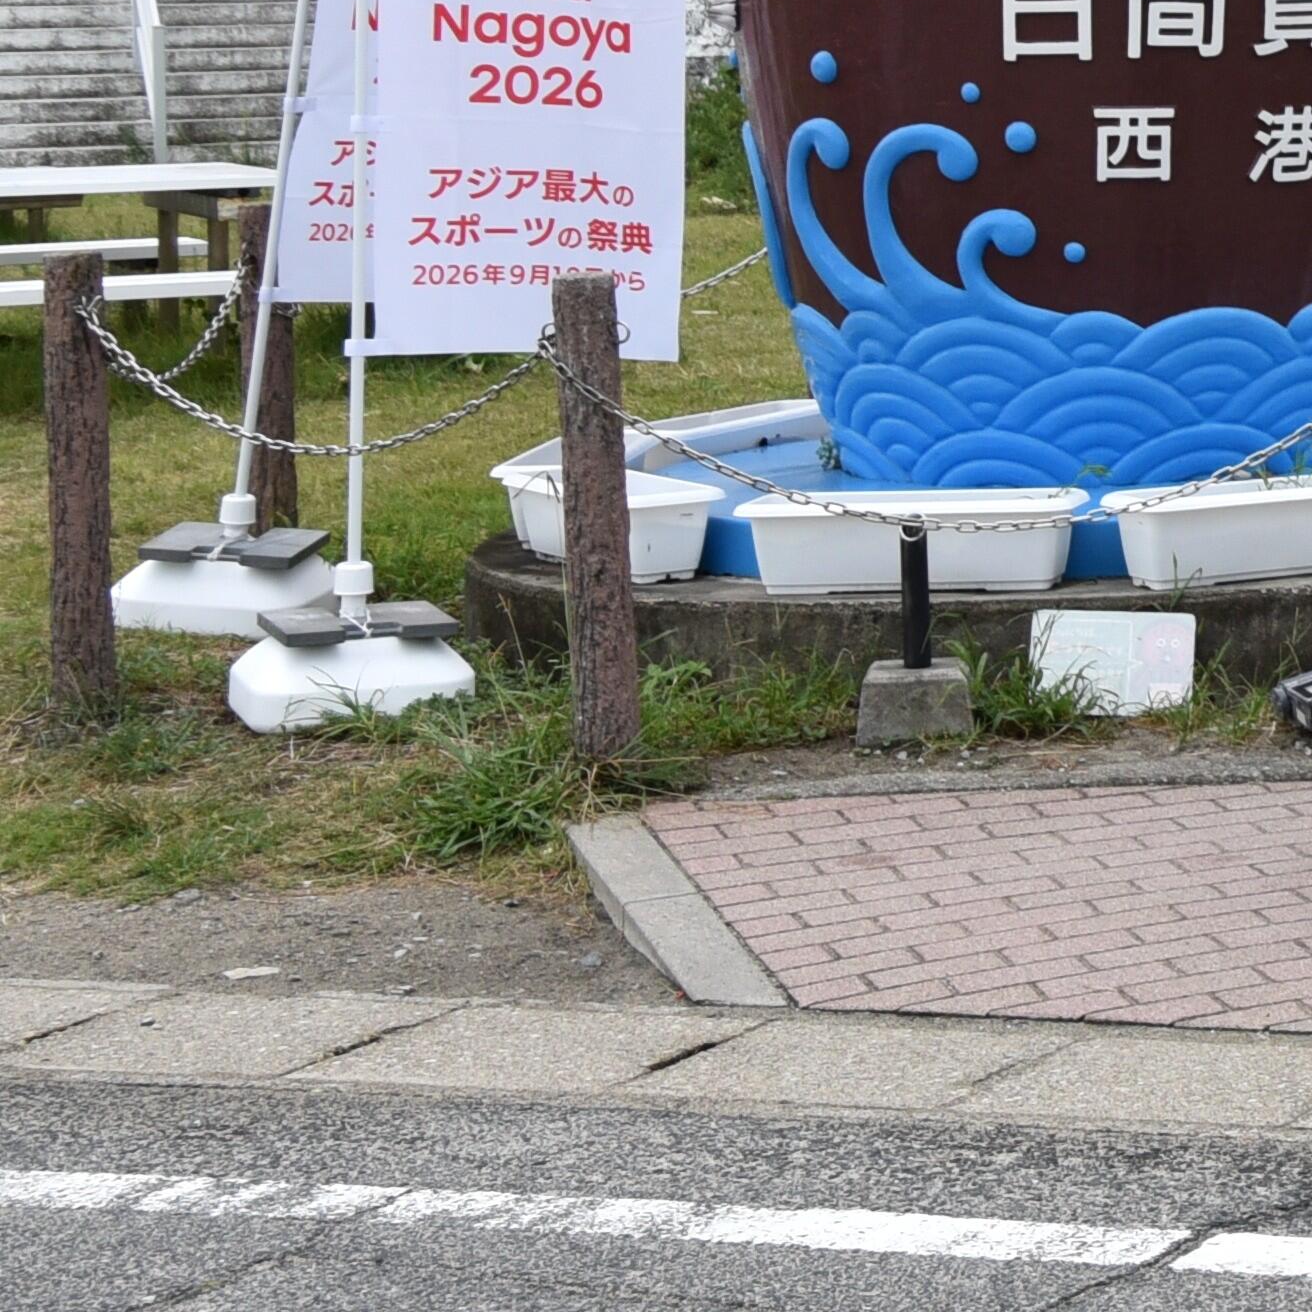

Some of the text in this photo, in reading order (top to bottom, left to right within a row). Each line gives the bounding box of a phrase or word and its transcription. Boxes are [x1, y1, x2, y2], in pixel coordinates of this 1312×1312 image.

[432, 3, 632, 61] Nagoya
[468, 63, 604, 109] 2026
[427, 166, 635, 208] アジア最大の
[407, 212, 654, 256] スポーツの祭典
[411, 263, 646, 292] 2026年9月から
